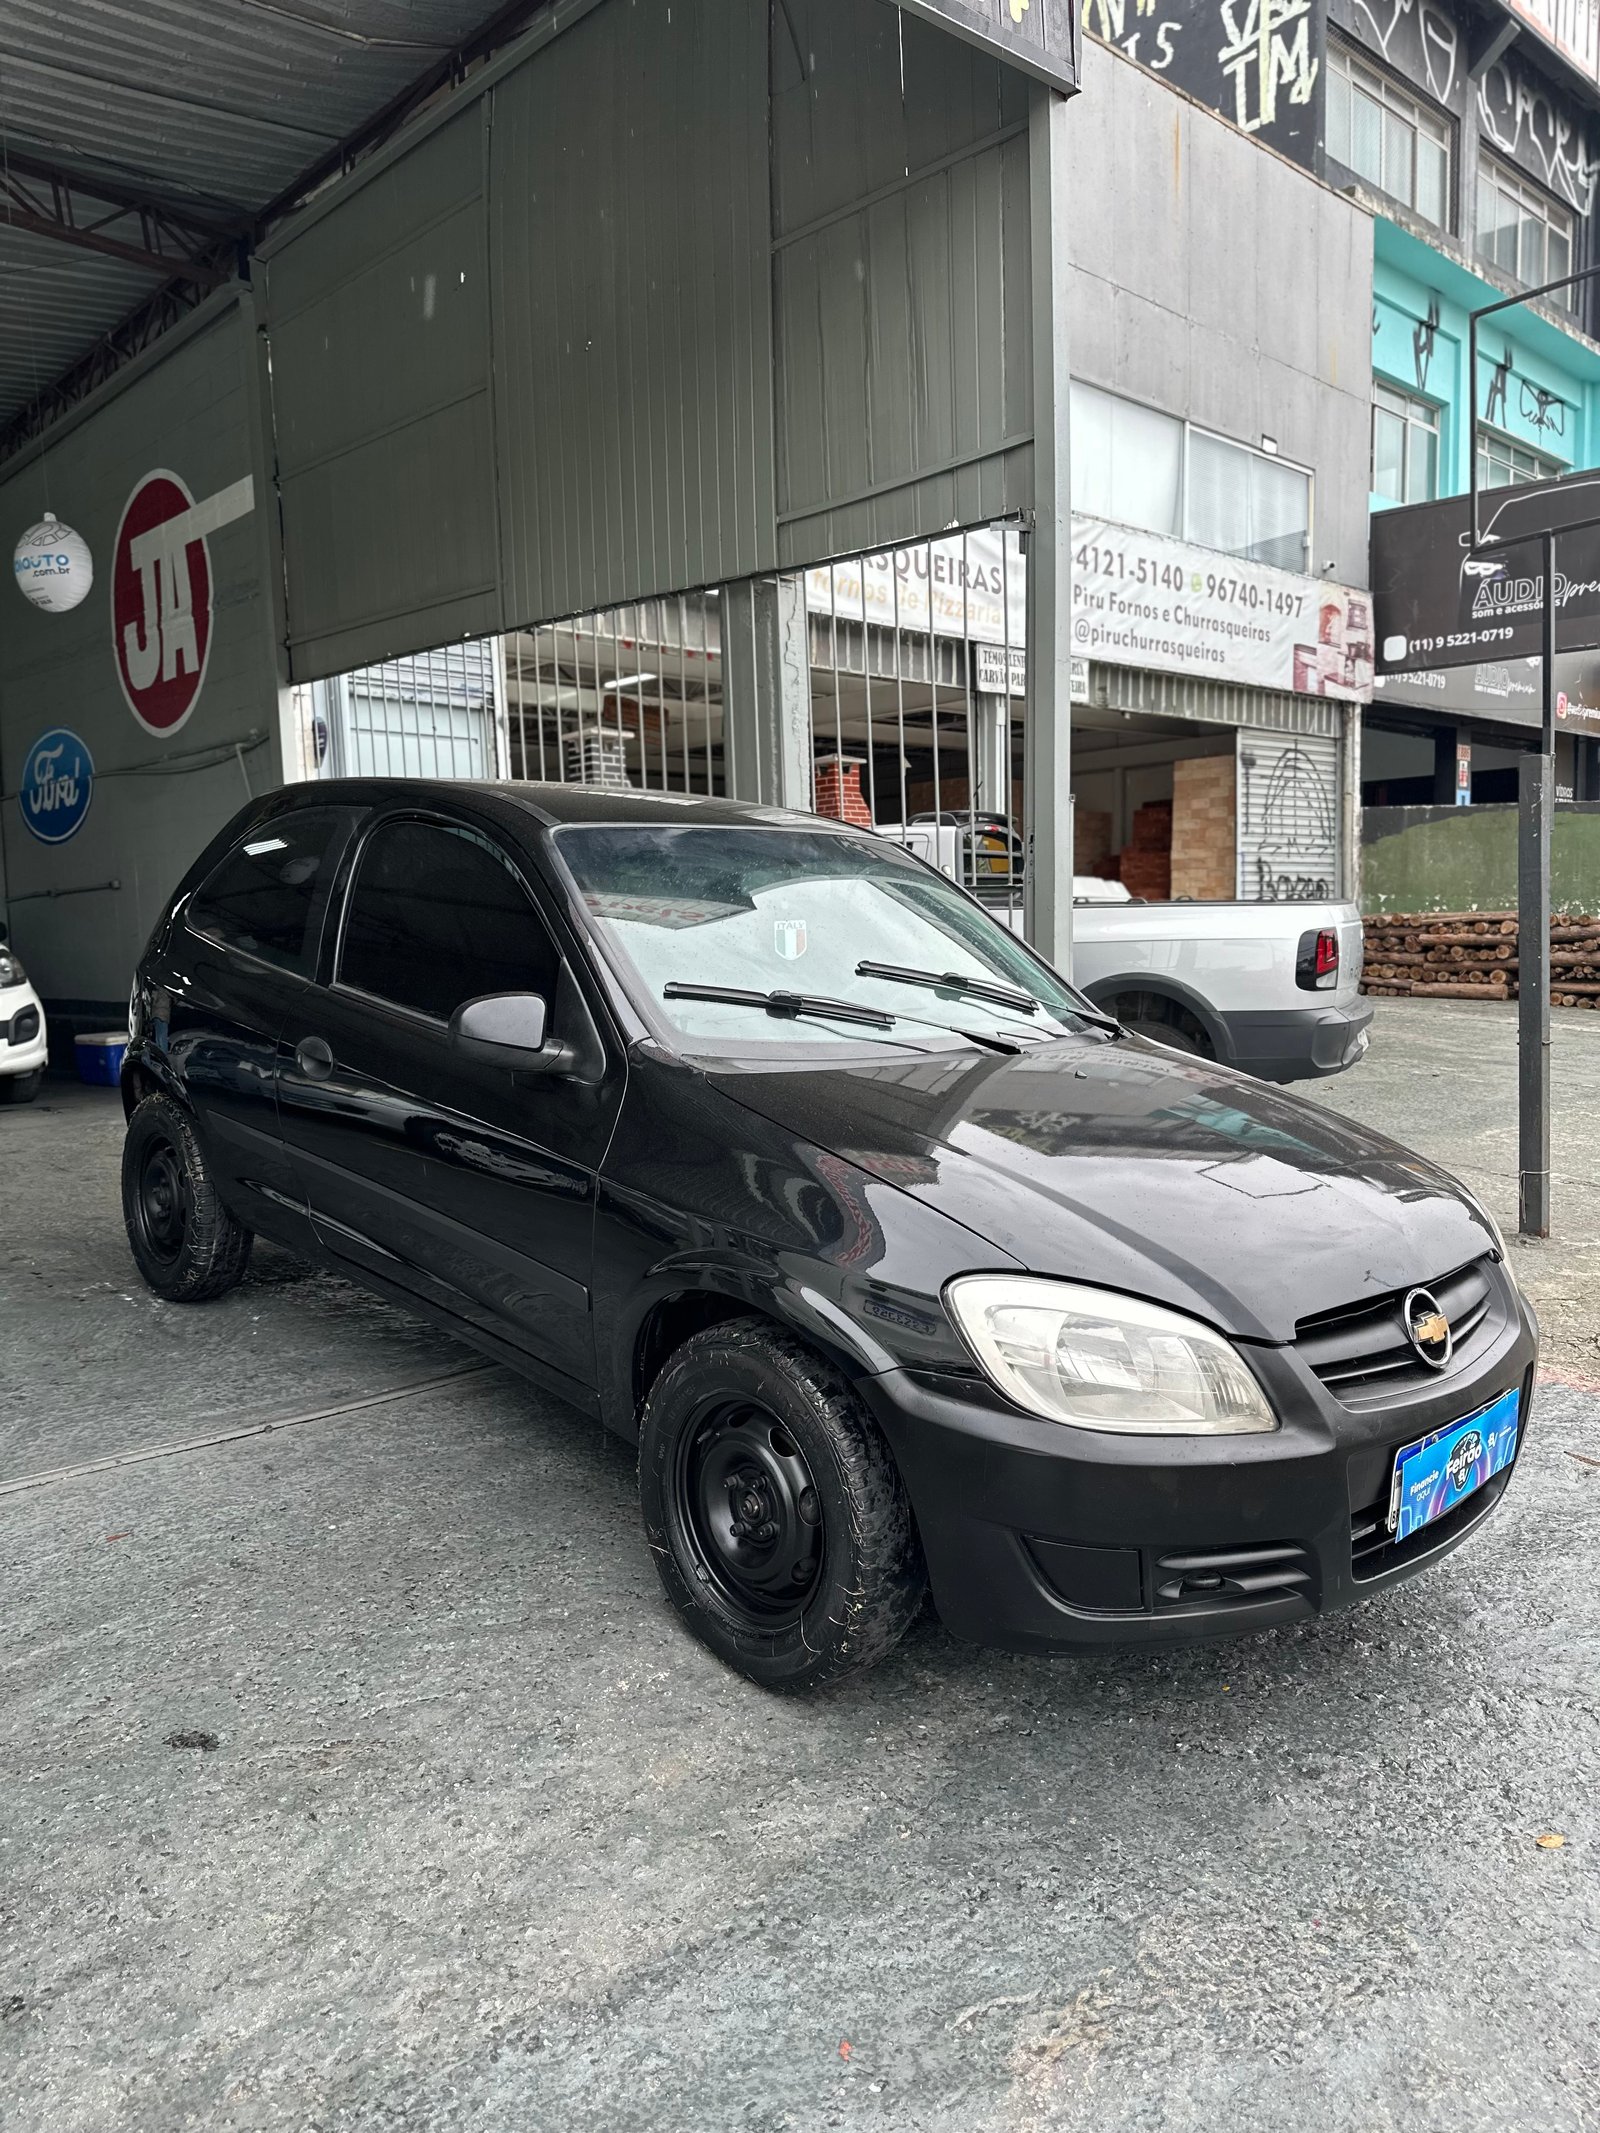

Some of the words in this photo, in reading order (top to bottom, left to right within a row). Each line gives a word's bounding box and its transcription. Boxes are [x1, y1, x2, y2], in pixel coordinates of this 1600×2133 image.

[851, 547, 1003, 595] ASQUEIRAS
[1076, 544, 1184, 592] 4121-5140
[1206, 574, 1304, 619] 96740-1497
[1073, 584, 1105, 610] Piru
[1109, 592, 1159, 621] Fornos
[1162, 611, 1171, 622] e
[1174, 605, 1271, 643] Churrasqueiras
[1472, 608, 1494, 619] som
[1496, 607, 1503, 615] e
[1075, 618, 1226, 663] @piruchurrasqueiras
[1409, 637, 1434, 653] (11)
[1436, 636, 1445, 648] 9
[1446, 626, 1514, 647] 5221-0719
[979, 667, 1006, 685] CARVÃ
[777, 922, 805, 930] ITALY
[1446, 1443, 1482, 1481] Feirão
[1410, 1469, 1440, 1496] Financie
